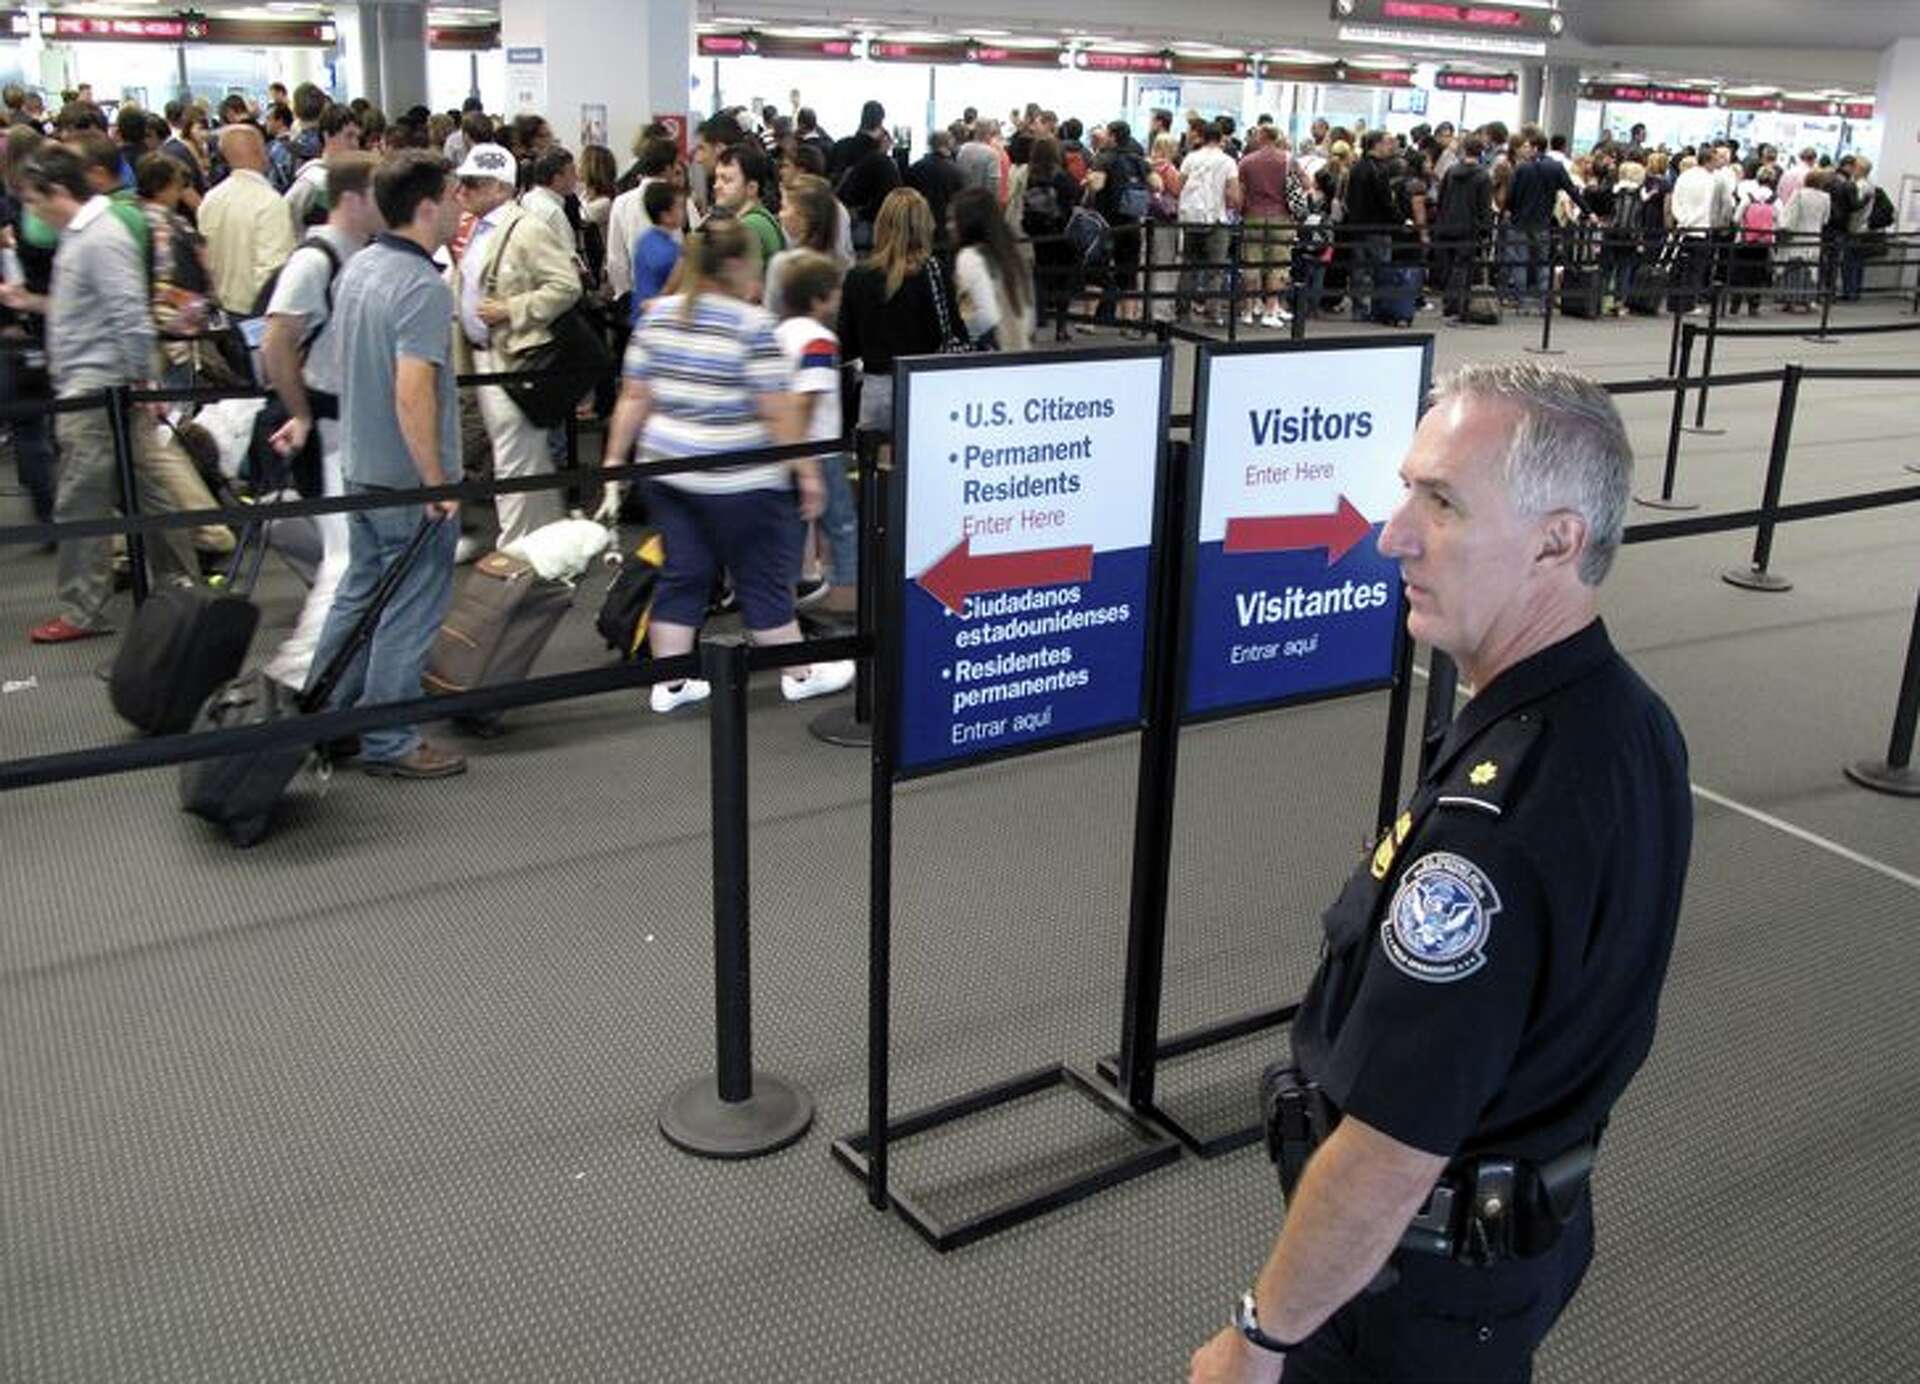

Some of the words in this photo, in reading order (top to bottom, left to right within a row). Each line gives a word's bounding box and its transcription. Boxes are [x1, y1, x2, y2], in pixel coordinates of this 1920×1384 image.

[965, 400, 1014, 429] U.S.
[1023, 396, 1116, 424] Citizens
[1249, 406, 1373, 446] Visitors
[964, 435, 1093, 470] Permanent
[963, 471, 1081, 504] Residents
[1246, 462, 1291, 486] Enter
[1295, 460, 1335, 482] Here
[963, 513, 1014, 537] Enter
[1021, 508, 1066, 531] Here
[960, 586, 1081, 620] Ciudadanos
[1235, 579, 1388, 628] Visitantes
[955, 604, 1130, 648] estadounidenses
[955, 646, 1073, 683] Residentes
[1231, 643, 1280, 664] Entrar
[952, 668, 1090, 713] permanentes
[951, 717, 1008, 744] Entrar
